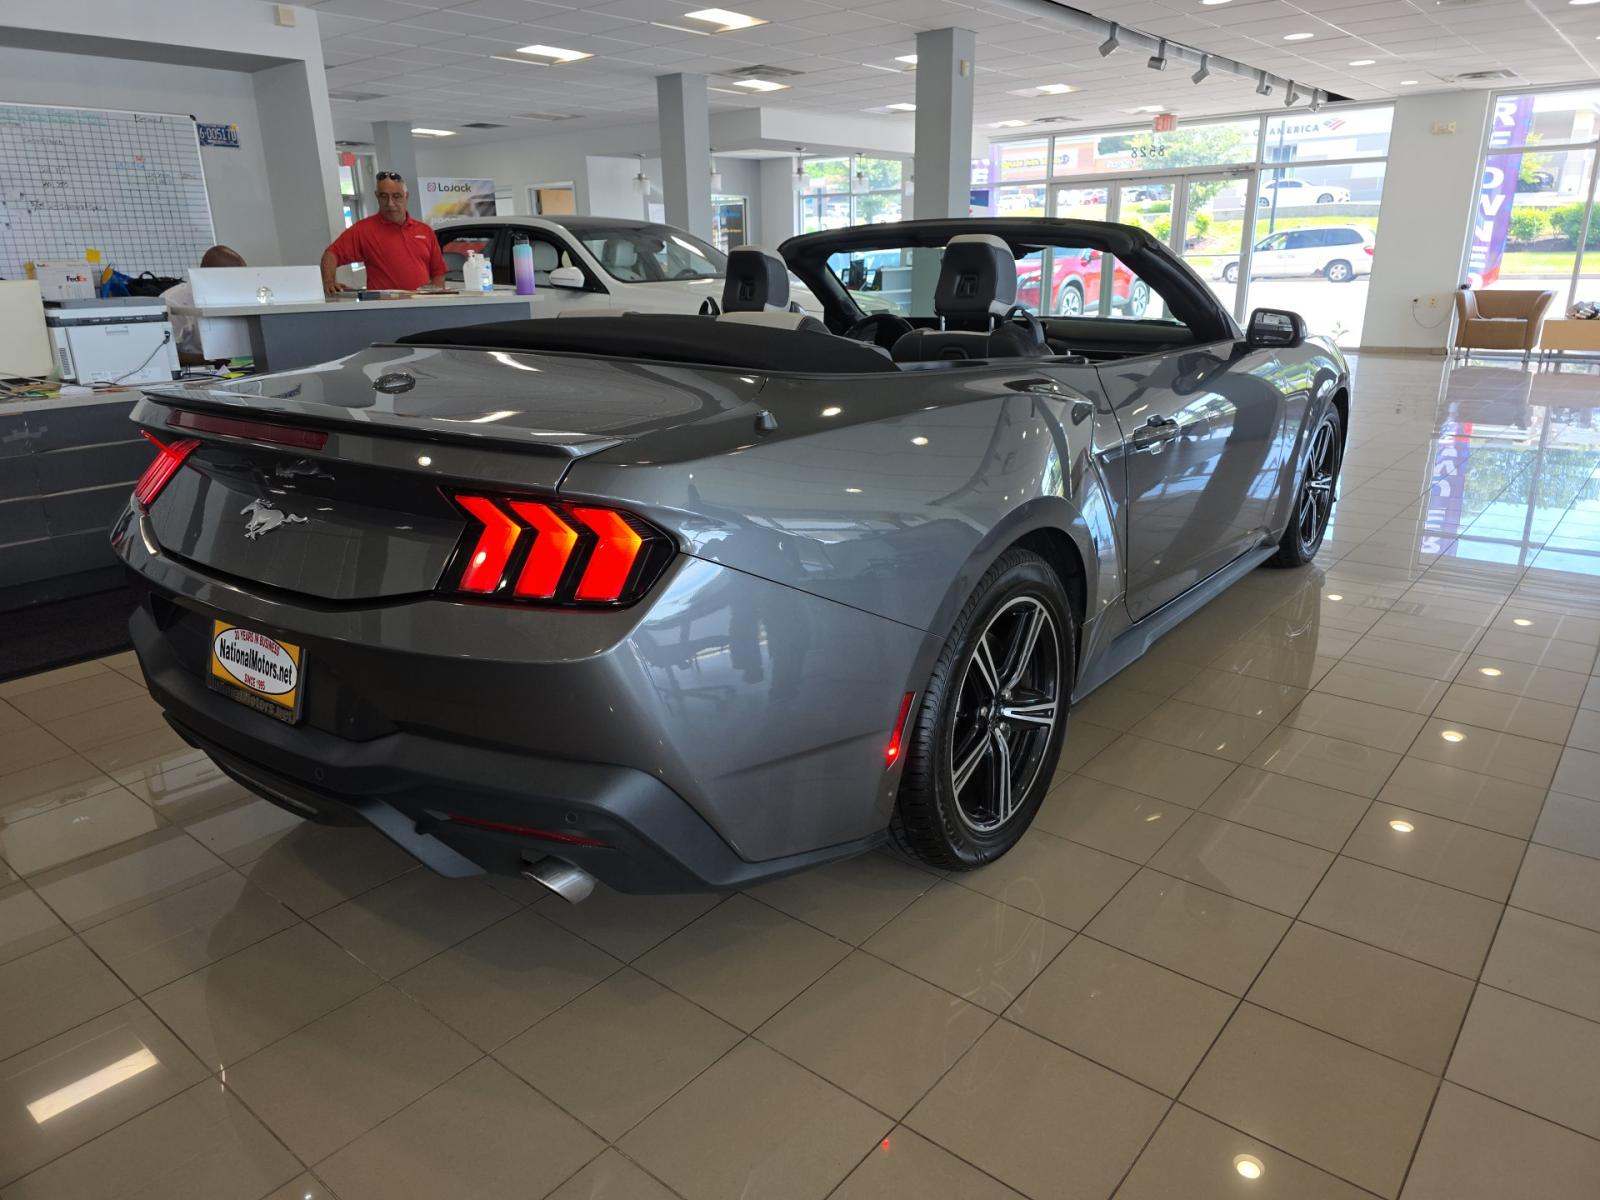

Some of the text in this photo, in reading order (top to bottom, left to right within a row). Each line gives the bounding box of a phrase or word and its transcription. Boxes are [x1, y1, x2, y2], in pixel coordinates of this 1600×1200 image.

[438, 182, 472, 193] LoJack
[260, 635, 281, 657] BUSINESS
[219, 637, 293, 686] NationalMotors.net
[244, 673, 256, 687] SINCE
